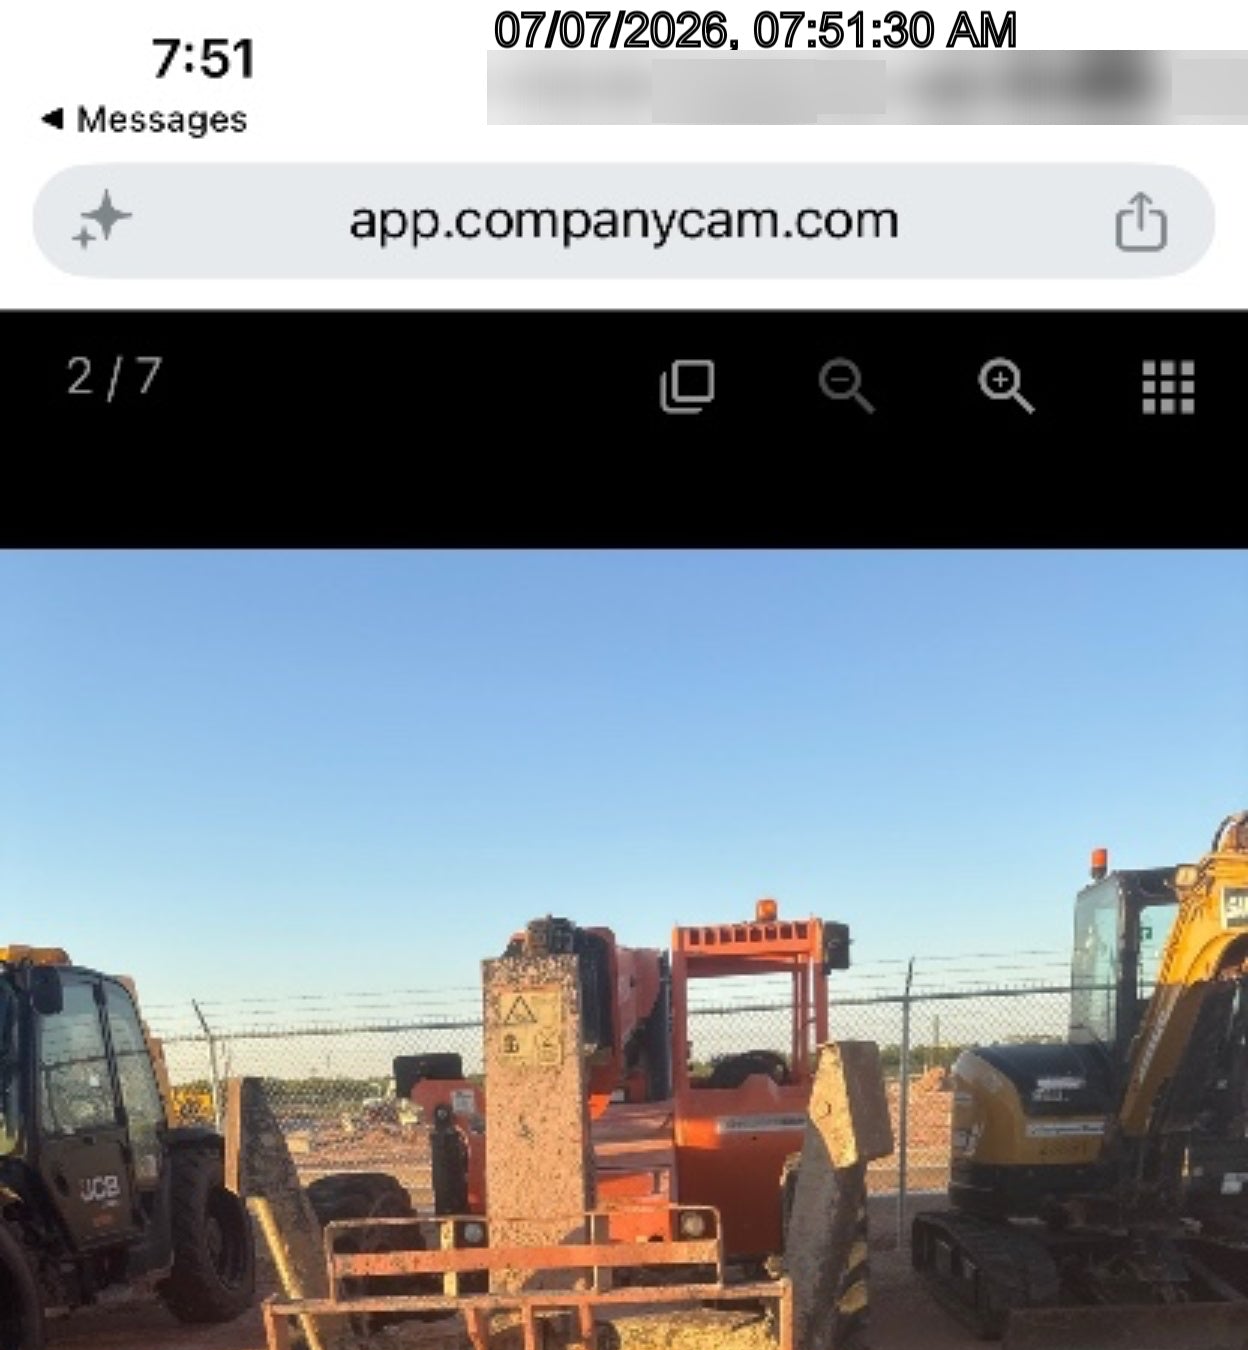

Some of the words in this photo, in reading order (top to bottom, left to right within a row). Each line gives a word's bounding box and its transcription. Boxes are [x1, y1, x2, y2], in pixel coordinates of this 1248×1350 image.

[152, 38, 253, 79] 7:51
[78, 105, 248, 139] Messages
[350, 206, 899, 250] app.companycam.com
[68, 357, 93, 394] 2
[136, 357, 162, 394] 7
[80, 1175, 120, 1201] JCB
